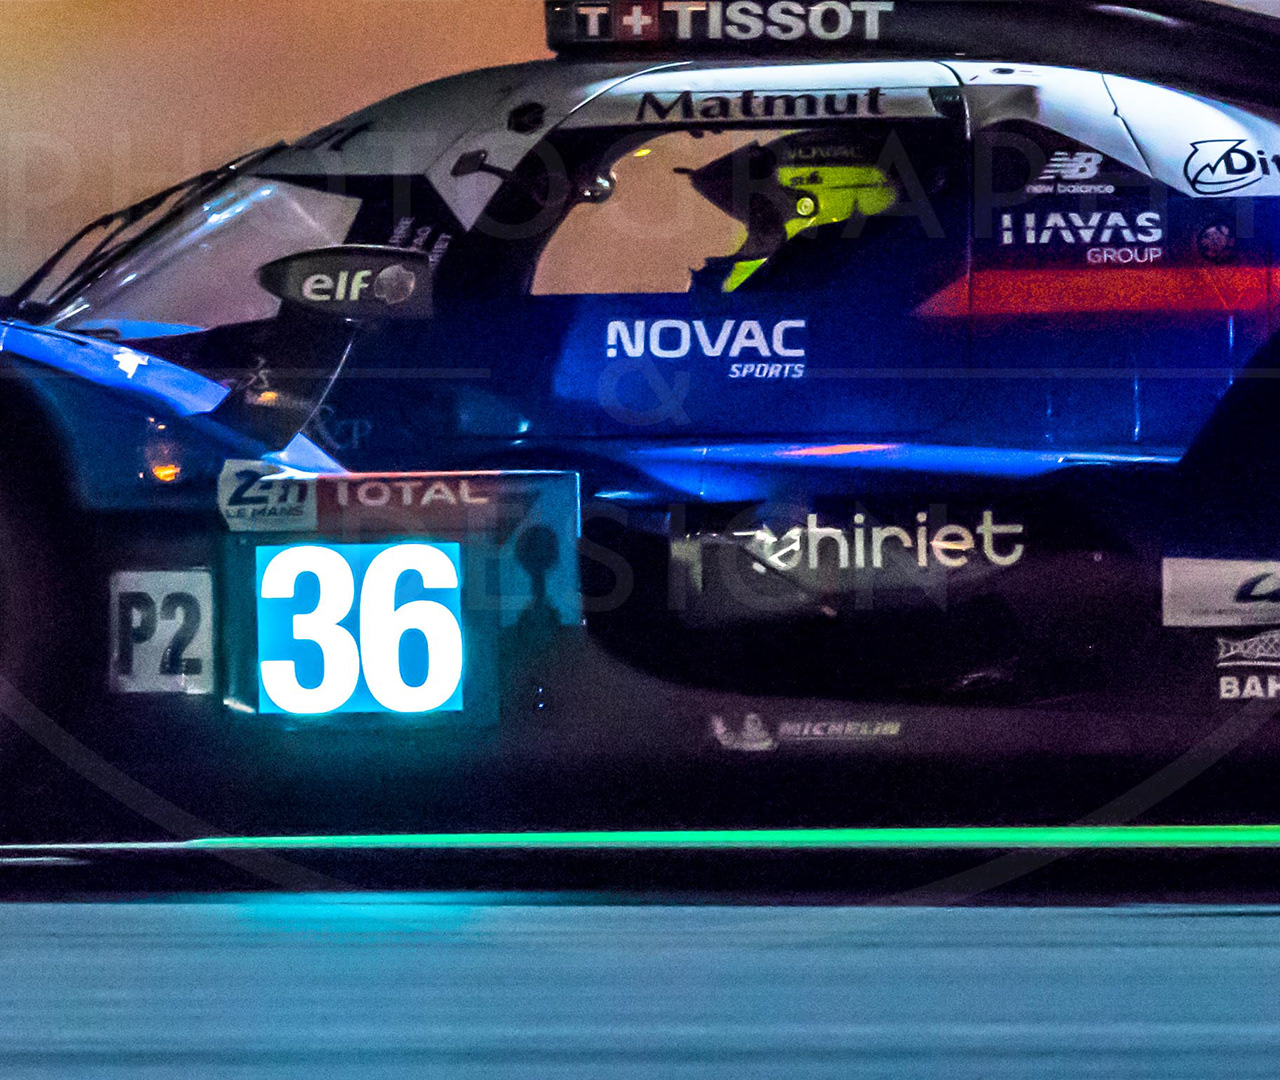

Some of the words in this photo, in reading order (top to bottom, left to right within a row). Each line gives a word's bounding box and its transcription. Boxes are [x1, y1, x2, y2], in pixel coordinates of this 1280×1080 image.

[663, 0, 894, 41] TISSOT
[636, 86, 885, 123] Matmut
[1001, 211, 1162, 244] HAVAS
[1088, 246, 1162, 263] GROUP
[302, 270, 373, 302] elf
[607, 319, 806, 358] NOVAC
[728, 362, 805, 379] SPORTS
[326, 478, 489, 506] TOTAL
[118, 592, 202, 675] P2
[260, 544, 463, 714] 36
[777, 721, 903, 737] MICHELIN
